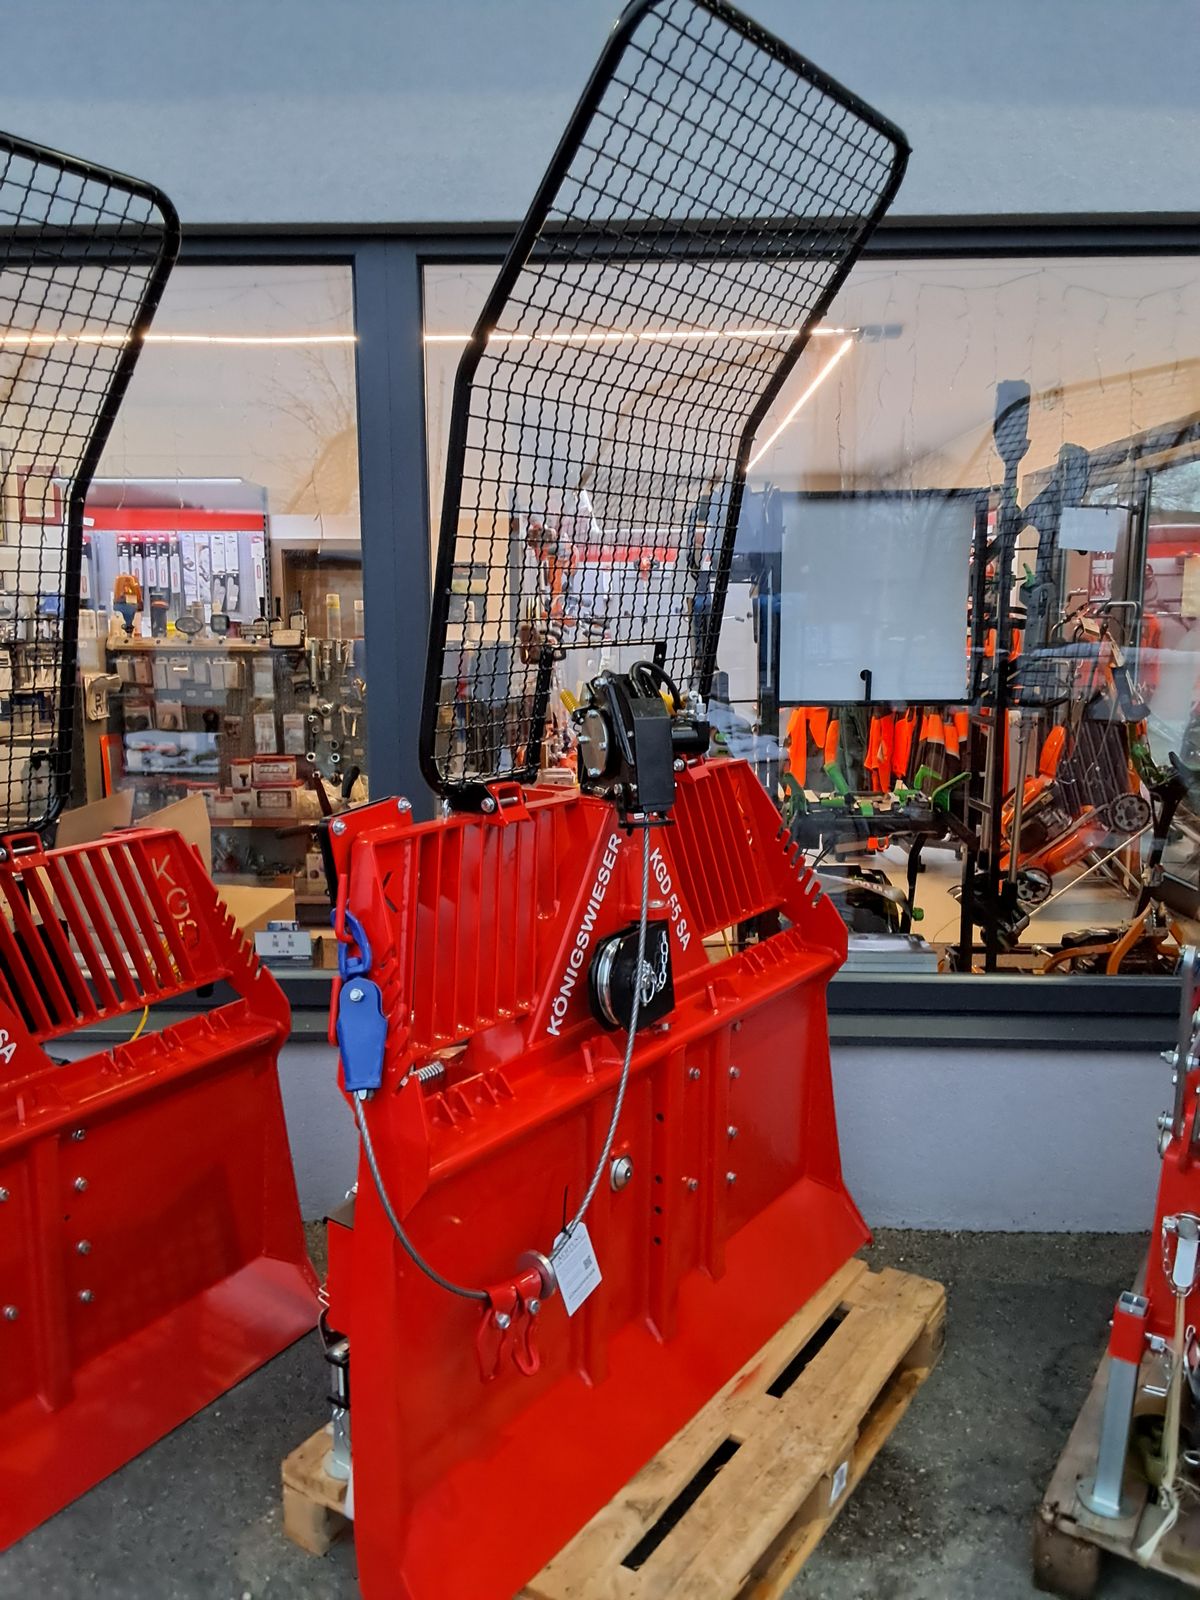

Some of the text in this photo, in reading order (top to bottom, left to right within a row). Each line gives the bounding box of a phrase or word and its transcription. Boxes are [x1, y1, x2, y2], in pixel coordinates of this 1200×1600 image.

[547, 833, 622, 1036] KÖNIGSWIESER
[650, 847, 691, 951] KGD 55 SA
